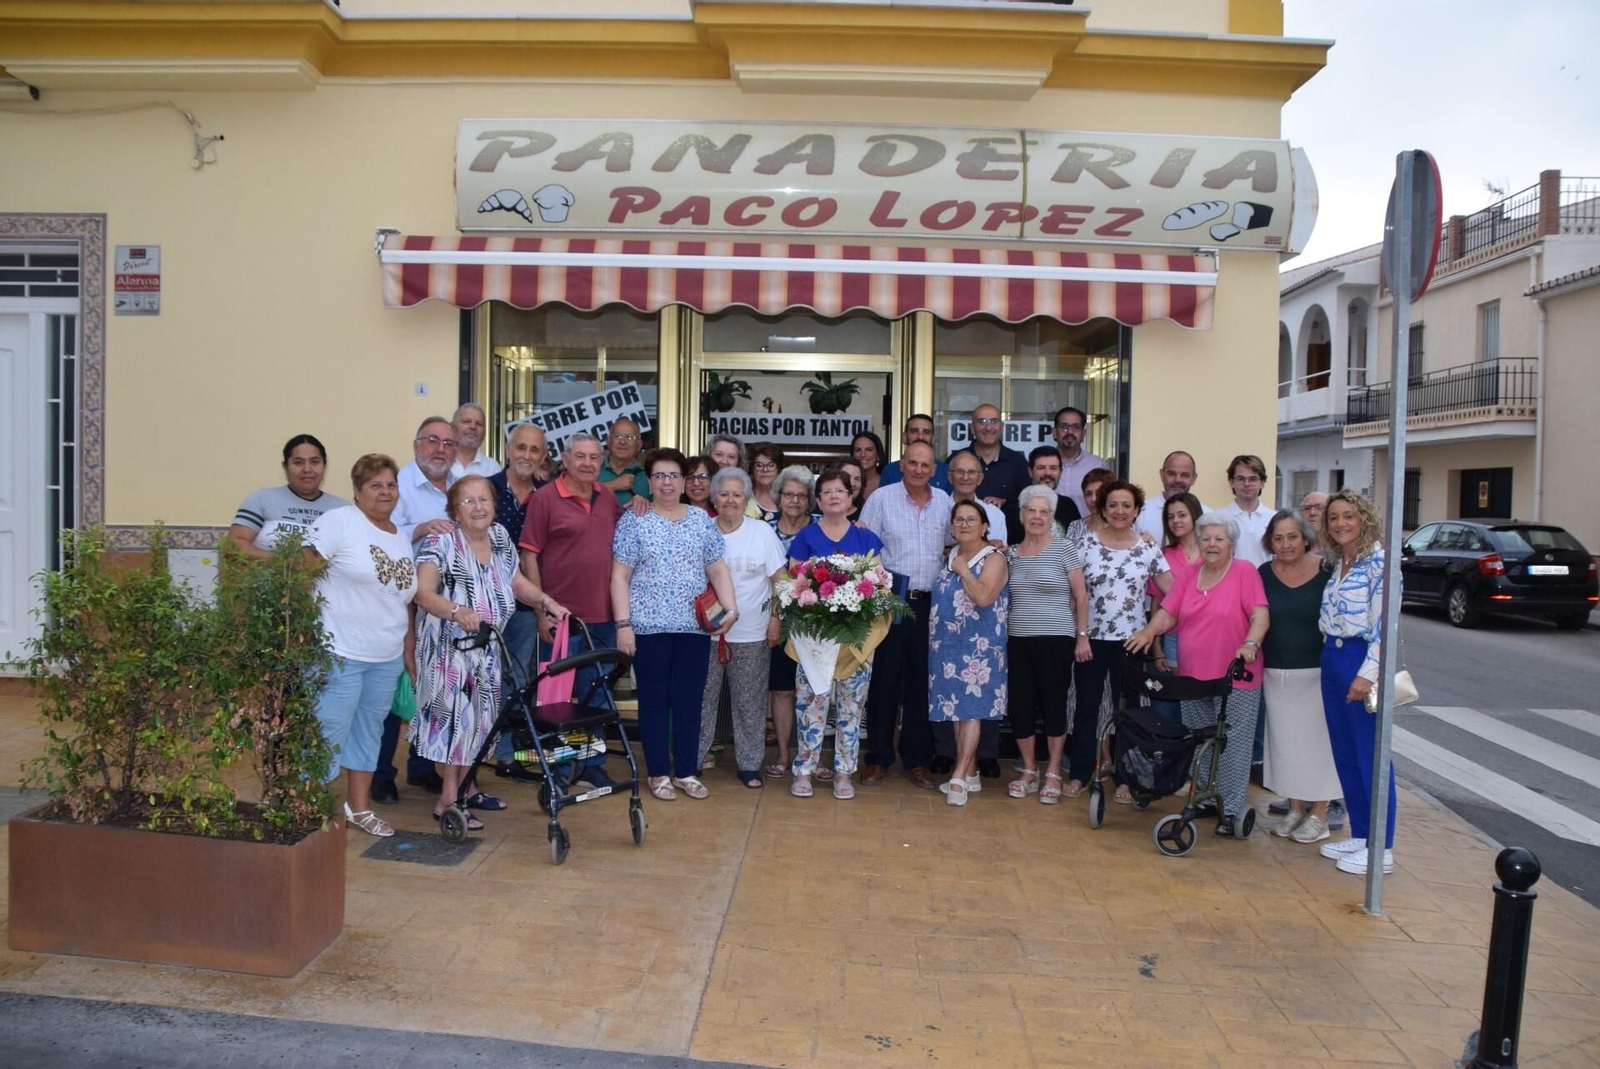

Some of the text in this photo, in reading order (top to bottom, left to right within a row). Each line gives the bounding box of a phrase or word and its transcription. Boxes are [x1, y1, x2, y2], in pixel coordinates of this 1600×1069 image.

[469, 129, 1278, 193] PANADERIA
[608, 186, 1146, 238] PACO LOPEZ
[116, 276, 160, 286] Alarma
[508, 385, 640, 434] ERRE POR
[708, 417, 869, 437] RACIAS POR TANTO!
[950, 422, 1032, 442] CIRE
[287, 507, 325, 517] DOWNTO
[277, 522, 308, 534] NORT
